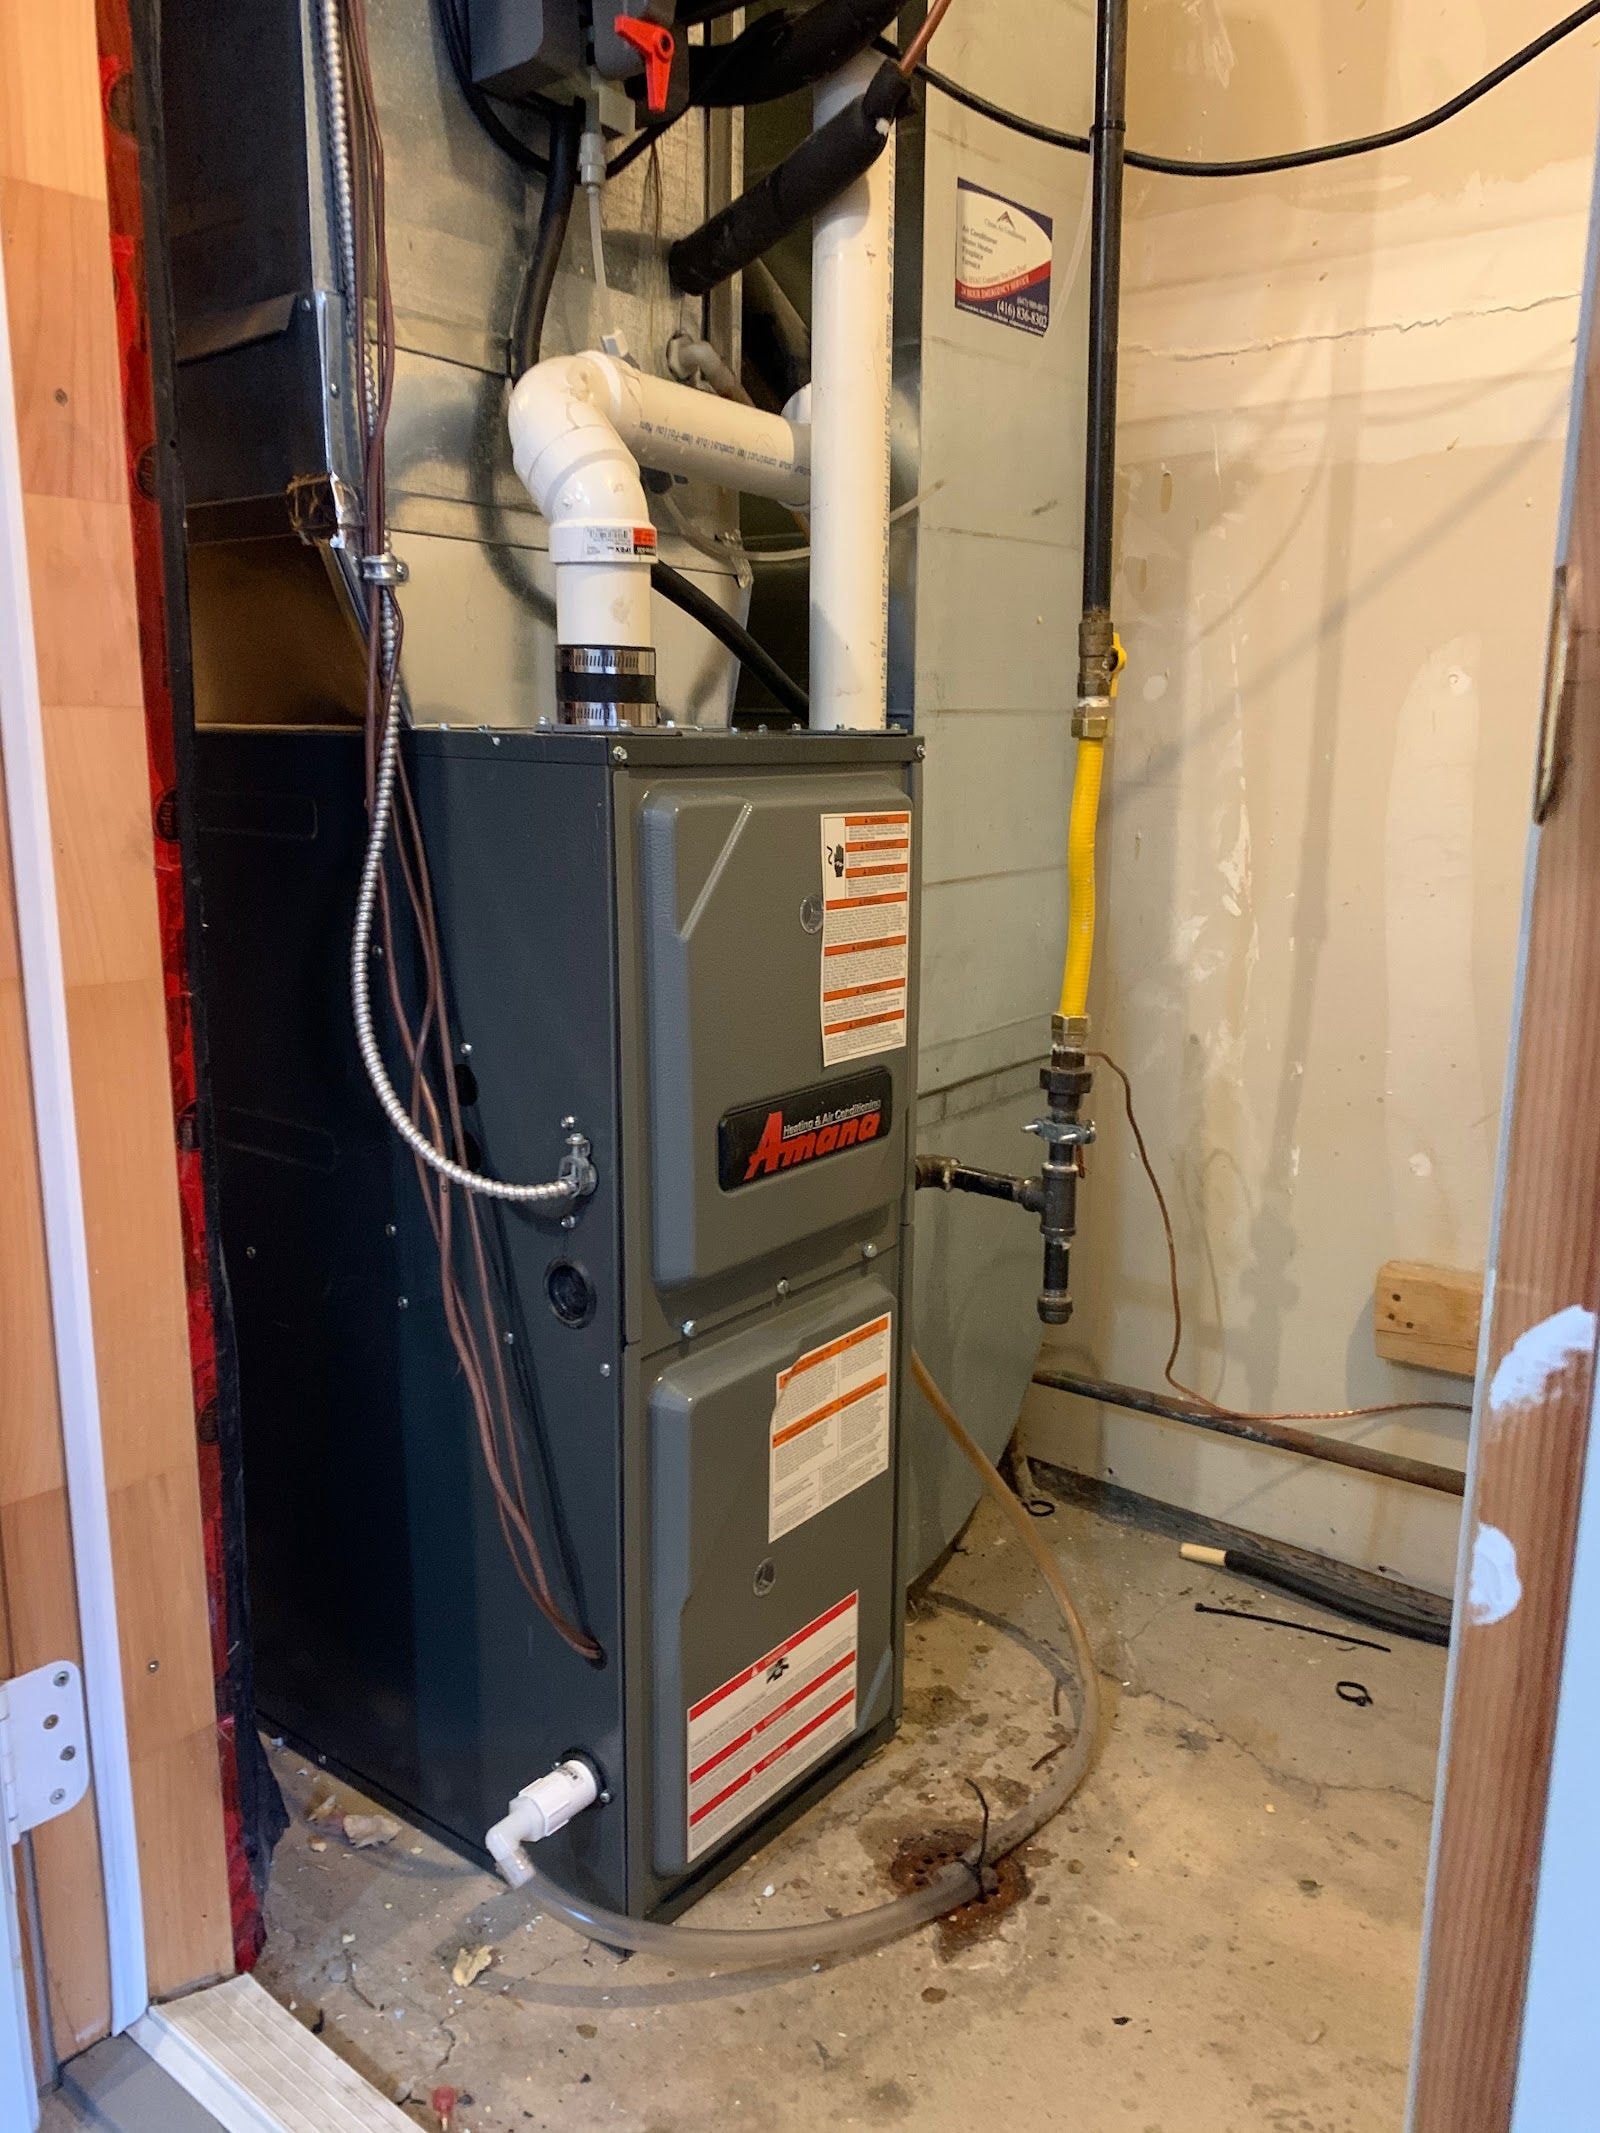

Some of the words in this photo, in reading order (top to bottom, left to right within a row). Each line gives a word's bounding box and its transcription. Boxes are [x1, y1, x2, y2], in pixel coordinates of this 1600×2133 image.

[997, 300, 1016, 321] (416)
[783, 1119, 814, 1137] Heating
[814, 1115, 822, 1126] &
[822, 1111, 833, 1125] Air
[834, 1099, 882, 1120] Conditioning
[743, 1110, 882, 1182] Amana
